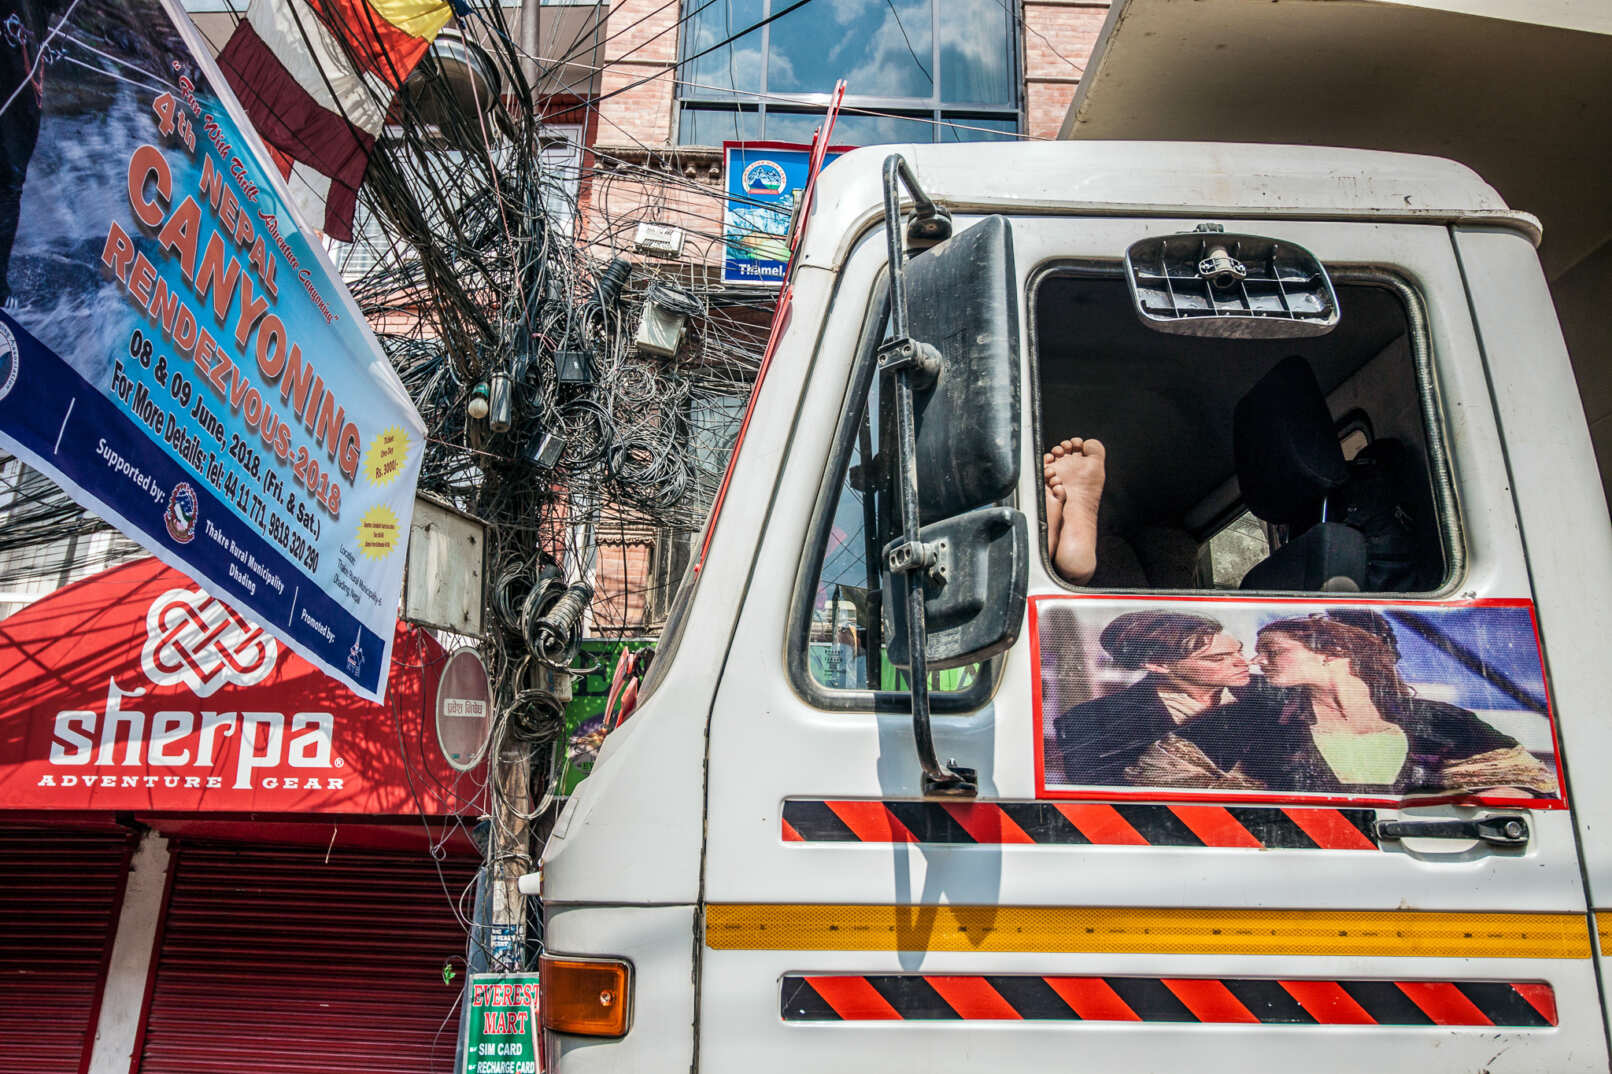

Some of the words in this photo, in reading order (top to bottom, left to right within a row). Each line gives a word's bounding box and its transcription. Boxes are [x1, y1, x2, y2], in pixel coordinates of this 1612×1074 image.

[152, 91, 197, 153] 4th
[199, 152, 278, 296] NEPAL
[204, 115, 232, 160] With
[257, 208, 299, 270] Adventure
[128, 144, 361, 480] CANYONING
[110, 359, 134, 405] For
[131, 380, 164, 435] More
[164, 411, 206, 474] Details:
[206, 452, 224, 491] Tel:
[224, 470, 238, 501] 44
[237, 482, 251, 514] 11
[249, 494, 267, 536] 771,
[268, 511, 290, 549] 9818
[289, 531, 306, 561] 320
[304, 544, 319, 574] 290
[129, 328, 153, 370] 08
[154, 355, 168, 389] &
[171, 372, 192, 408] 09
[190, 393, 227, 452] June,
[229, 432, 261, 482] 2018.
[263, 468, 284, 504] (Fri.
[286, 492, 296, 515] &
[296, 502, 321, 541] Sat.)
[95, 438, 151, 490] Supported
[149, 478, 166, 504] by:
[204, 520, 230, 549] Thakre
[229, 538, 248, 563] Rural
[247, 556, 285, 594] Municipality
[228, 563, 257, 595] Dhading
[301, 607, 328, 634] Promoted
[325, 627, 336, 644] by:
[49, 675, 335, 789] sherpa
[37, 775, 223, 789] ADVENTURE
[262, 777, 345, 790] GEAR
[472, 983, 540, 1007] EVEREST
[483, 1011, 528, 1035] MART
[477, 1061, 515, 1074] RECHARGE
[515, 1061, 536, 1074] CARD
[478, 1043, 496, 1056] SIM
[497, 1043, 523, 1056] CARD
